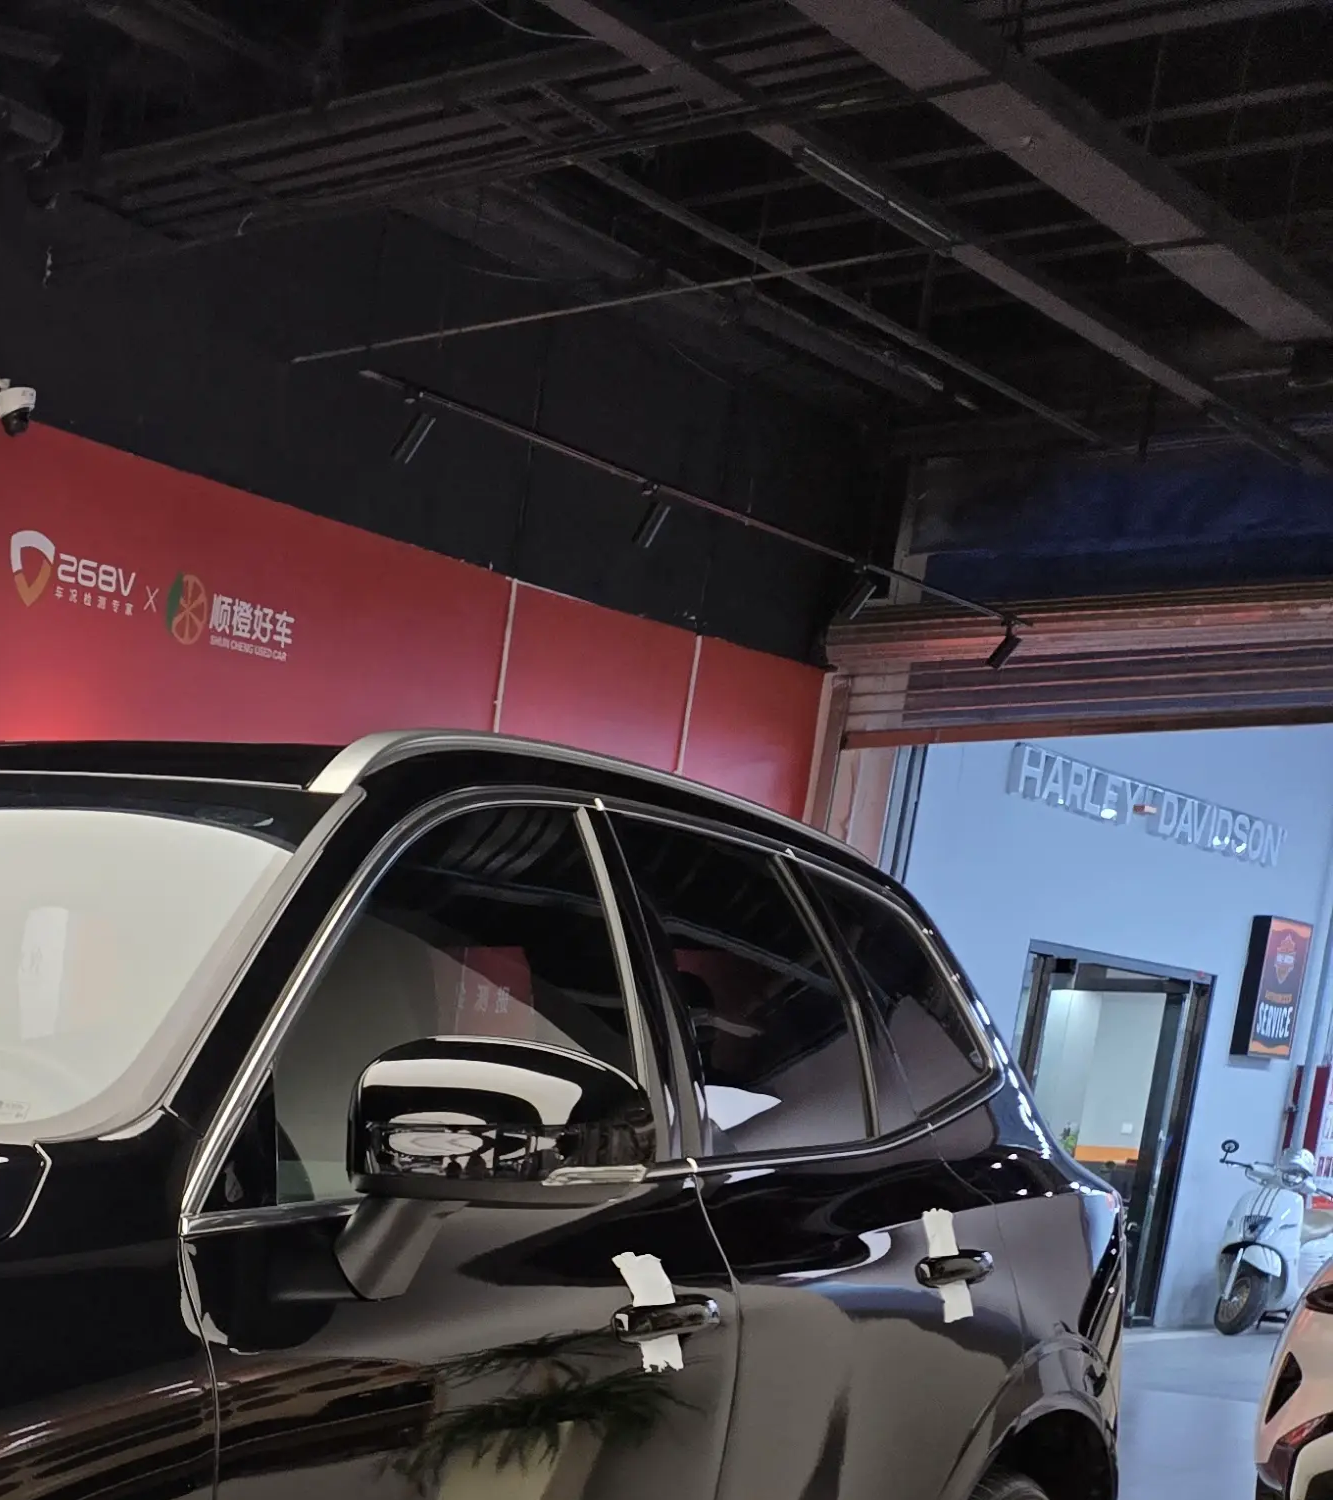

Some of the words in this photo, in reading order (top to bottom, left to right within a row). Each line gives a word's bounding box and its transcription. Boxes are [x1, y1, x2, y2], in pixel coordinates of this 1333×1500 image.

[57, 553, 136, 597] 268V
[209, 593, 295, 648] 顺橙好车
[1256, 1001, 1294, 1039] SERVICE
